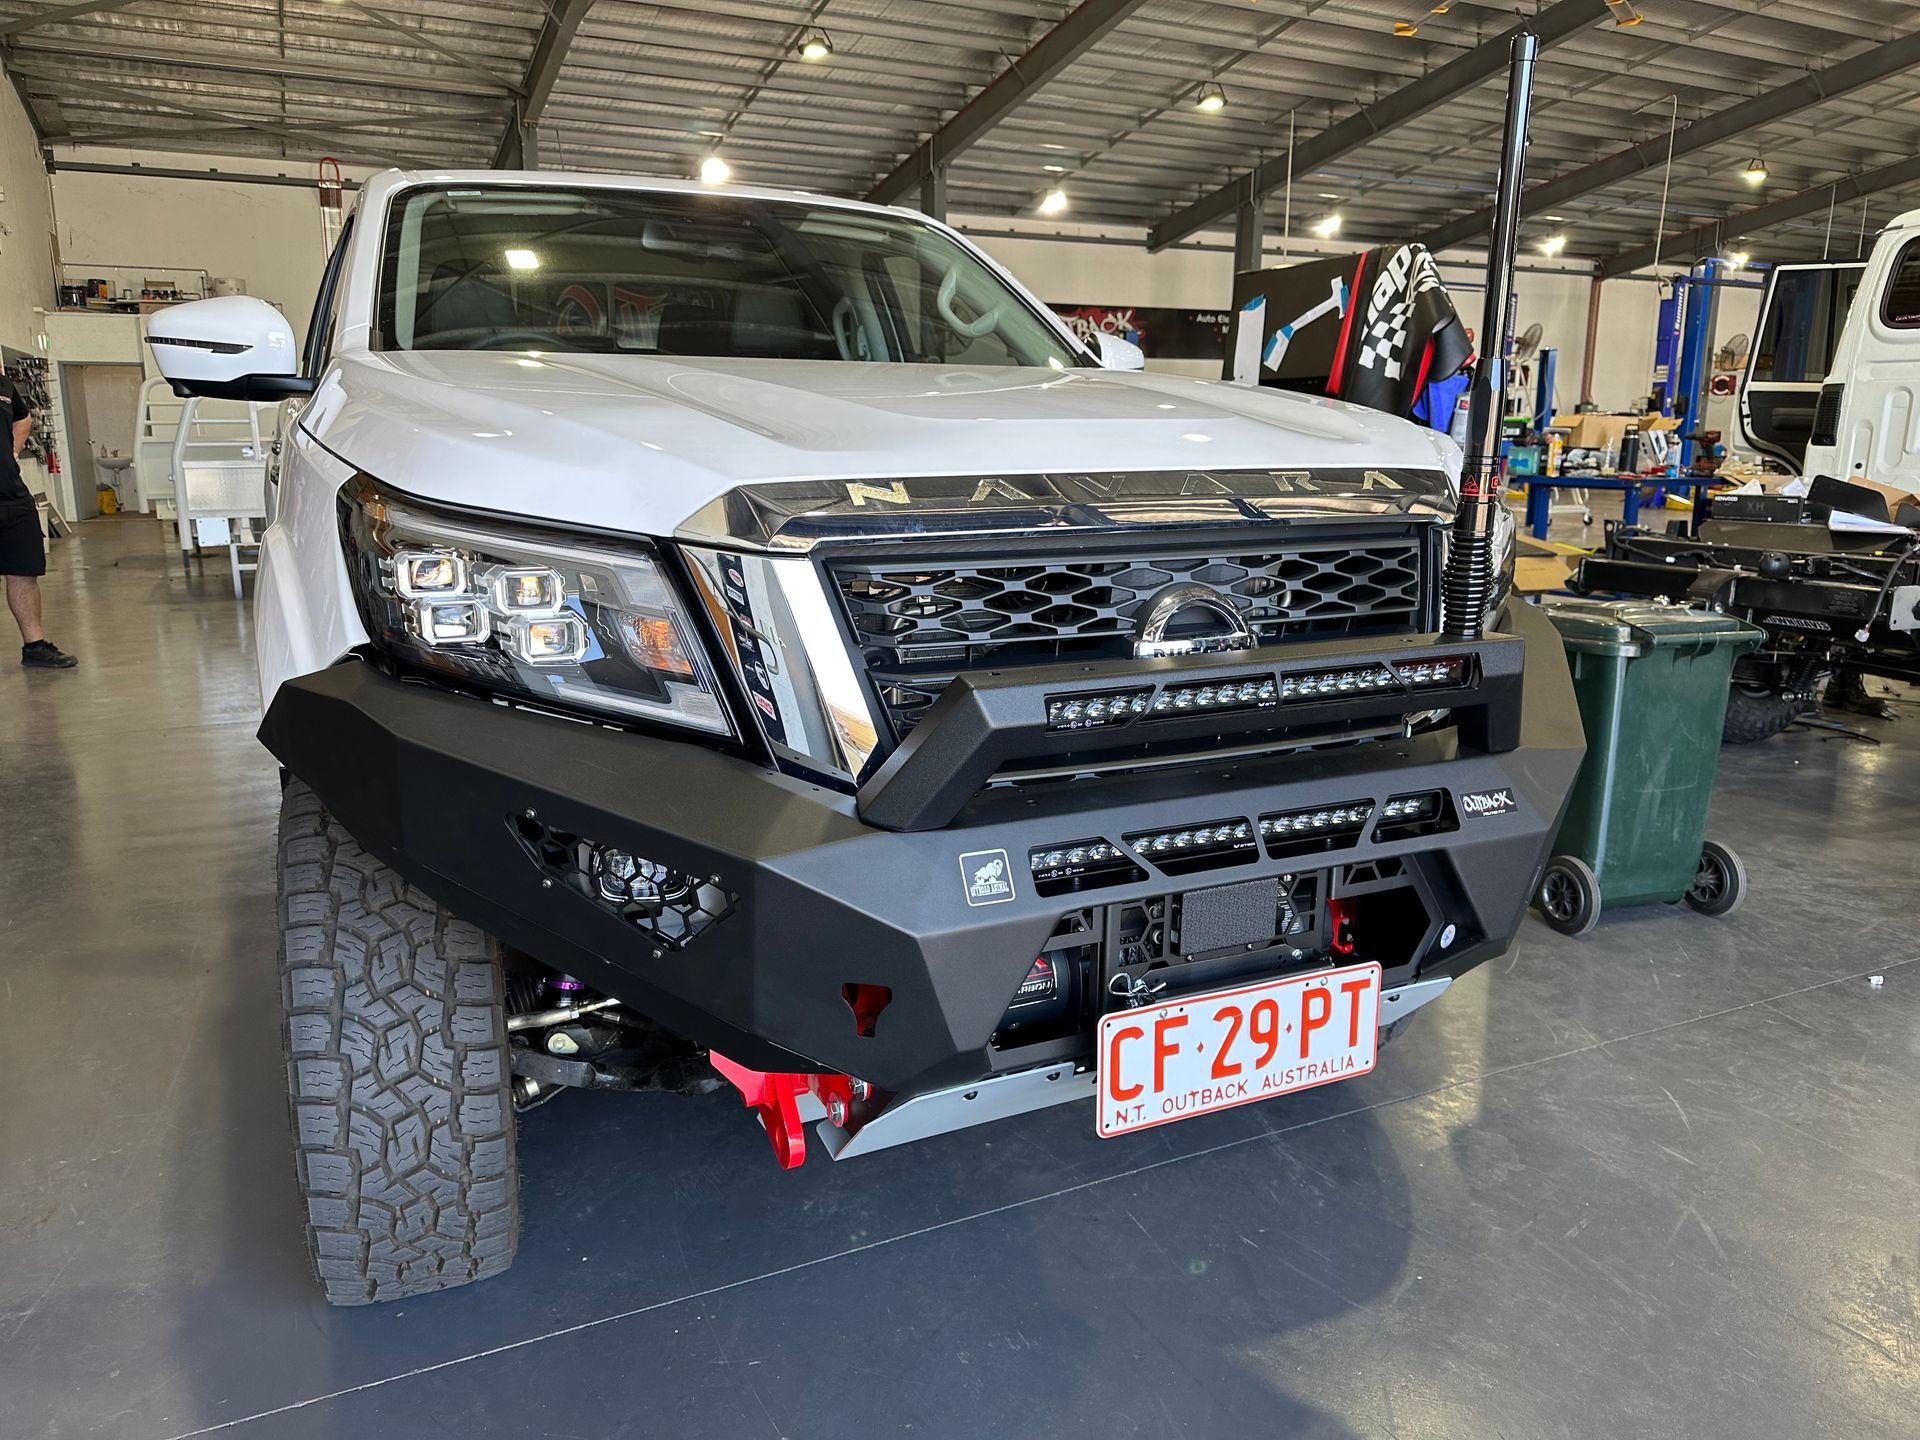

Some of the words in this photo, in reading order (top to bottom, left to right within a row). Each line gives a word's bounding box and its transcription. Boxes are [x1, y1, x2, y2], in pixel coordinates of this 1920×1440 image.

[846, 471, 1404, 505] NAVARA
[1116, 1104, 1146, 1126] N.T.
[1162, 1079, 1248, 1115] OUTBACK
[1262, 1054, 1354, 1091] AUSTRALIA
